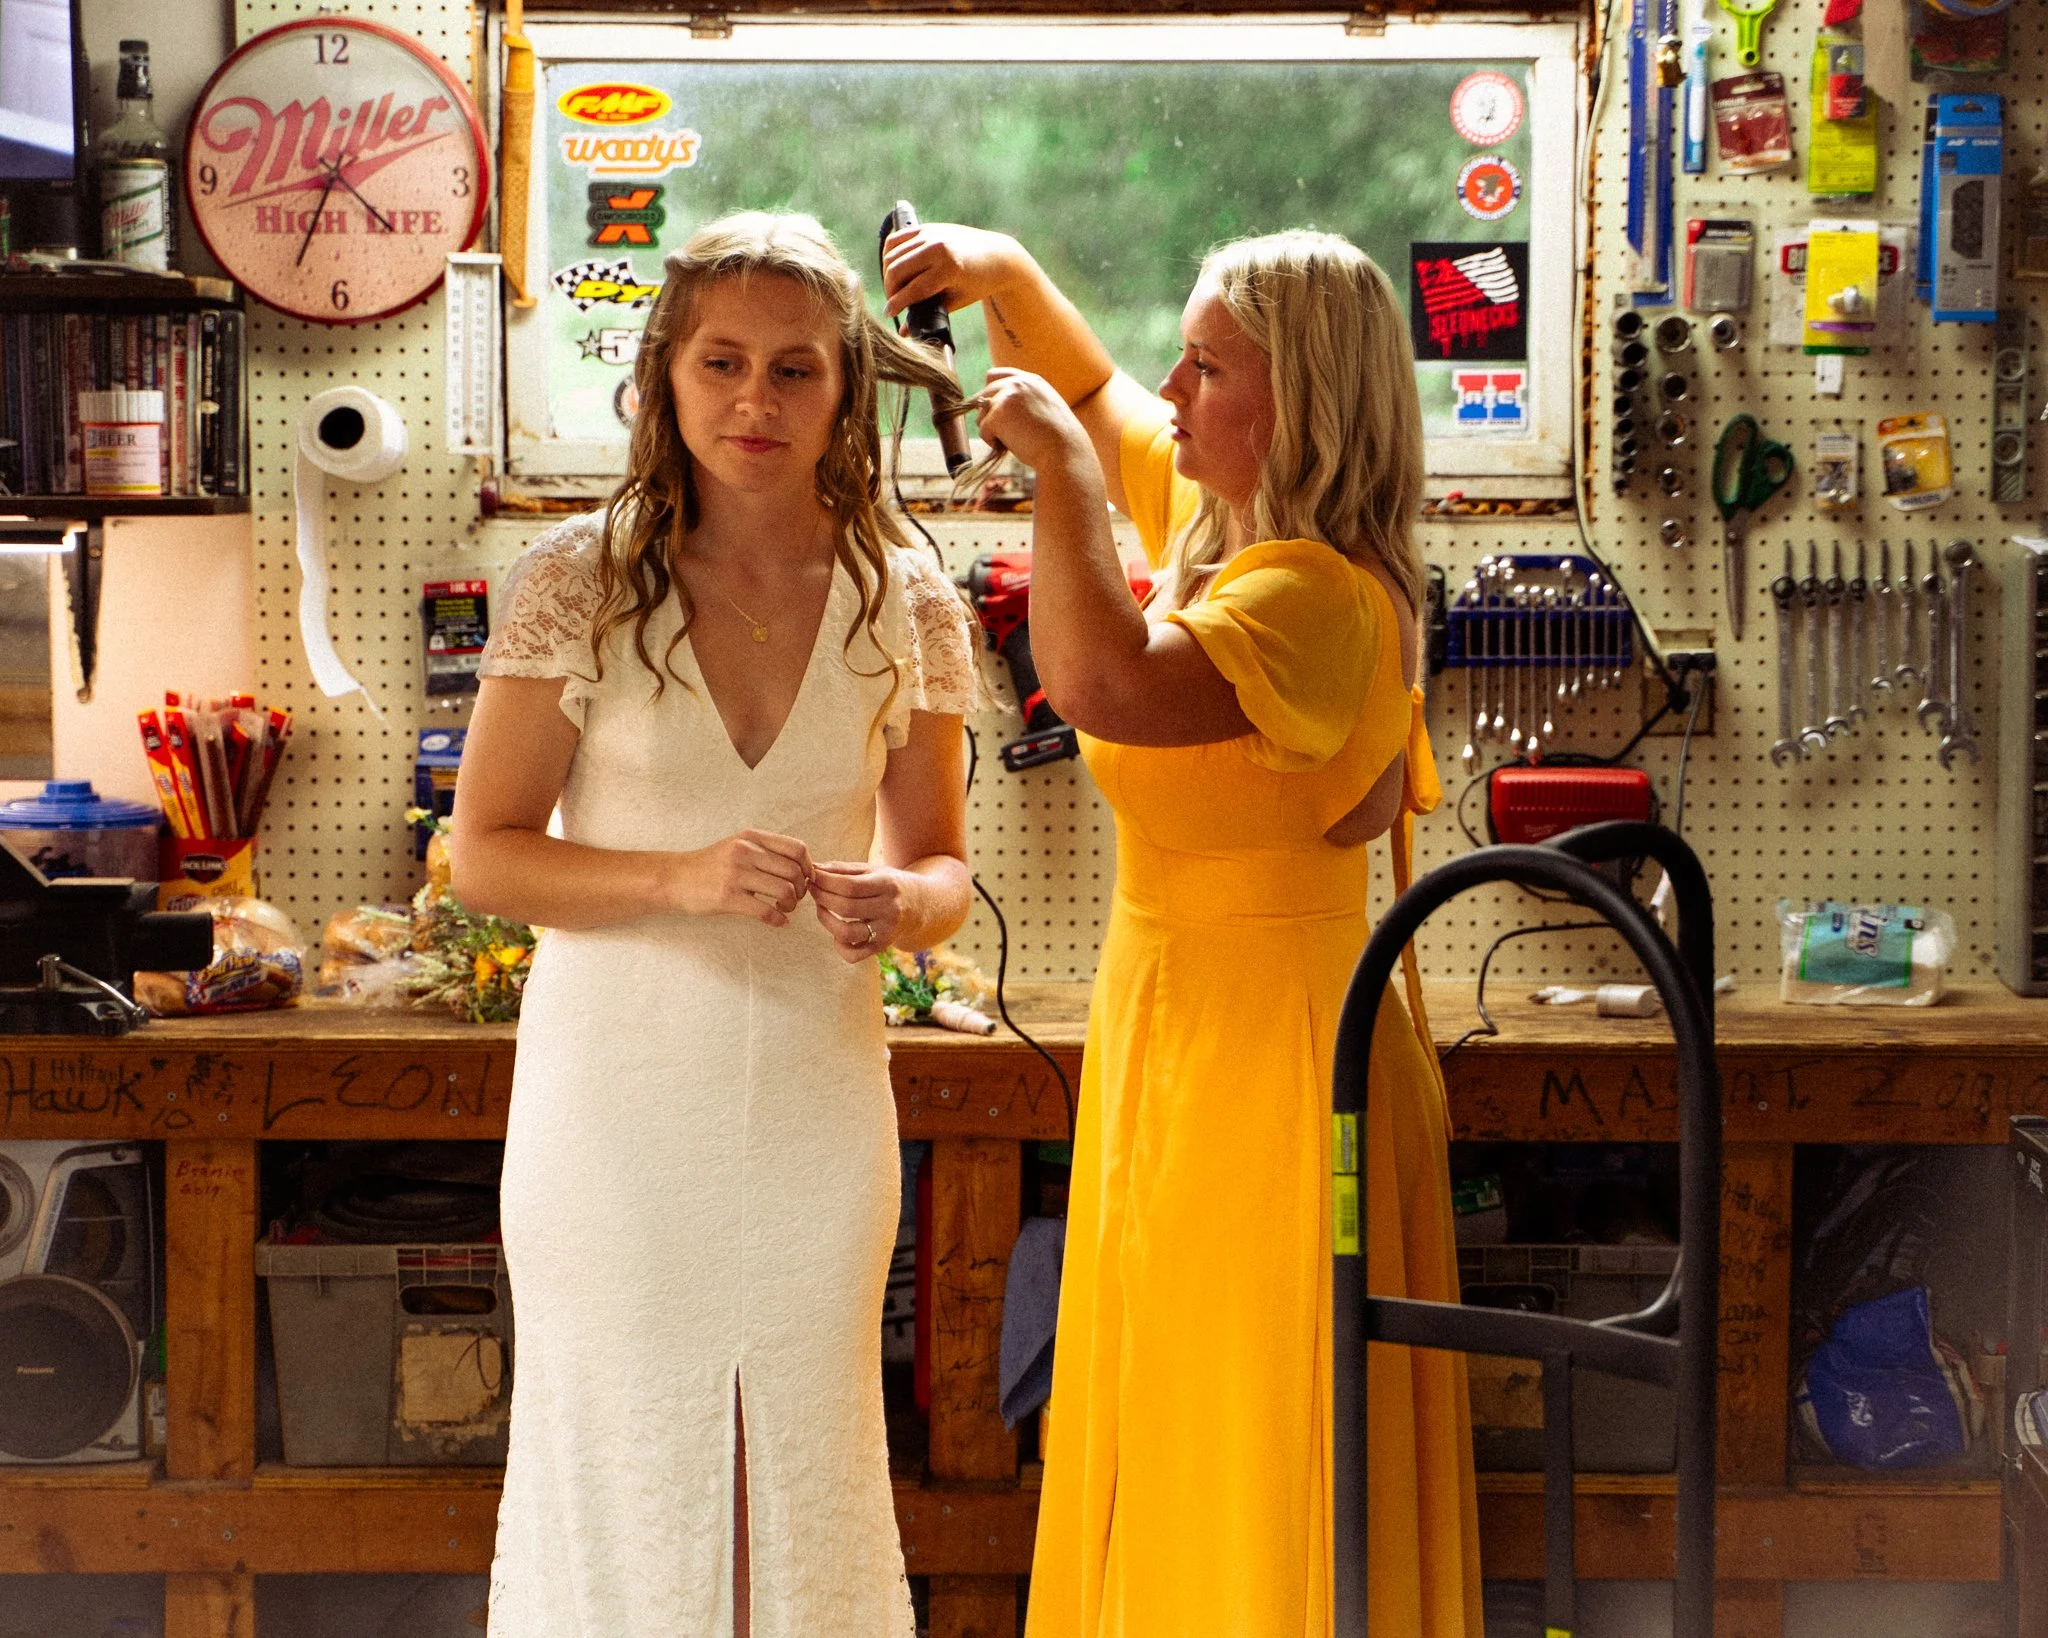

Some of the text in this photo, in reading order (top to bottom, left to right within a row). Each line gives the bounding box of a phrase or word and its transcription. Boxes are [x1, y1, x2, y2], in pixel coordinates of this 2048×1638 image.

[313, 33, 349, 65] 12
[569, 92, 663, 115] FMF
[199, 92, 450, 198] Miller
[564, 134, 695, 174] woody's
[199, 165, 217, 196] 9
[452, 167, 470, 198] 3
[254, 206, 349, 235] HIGH
[331, 280, 350, 311] 6
[574, 279, 661, 303] DY
